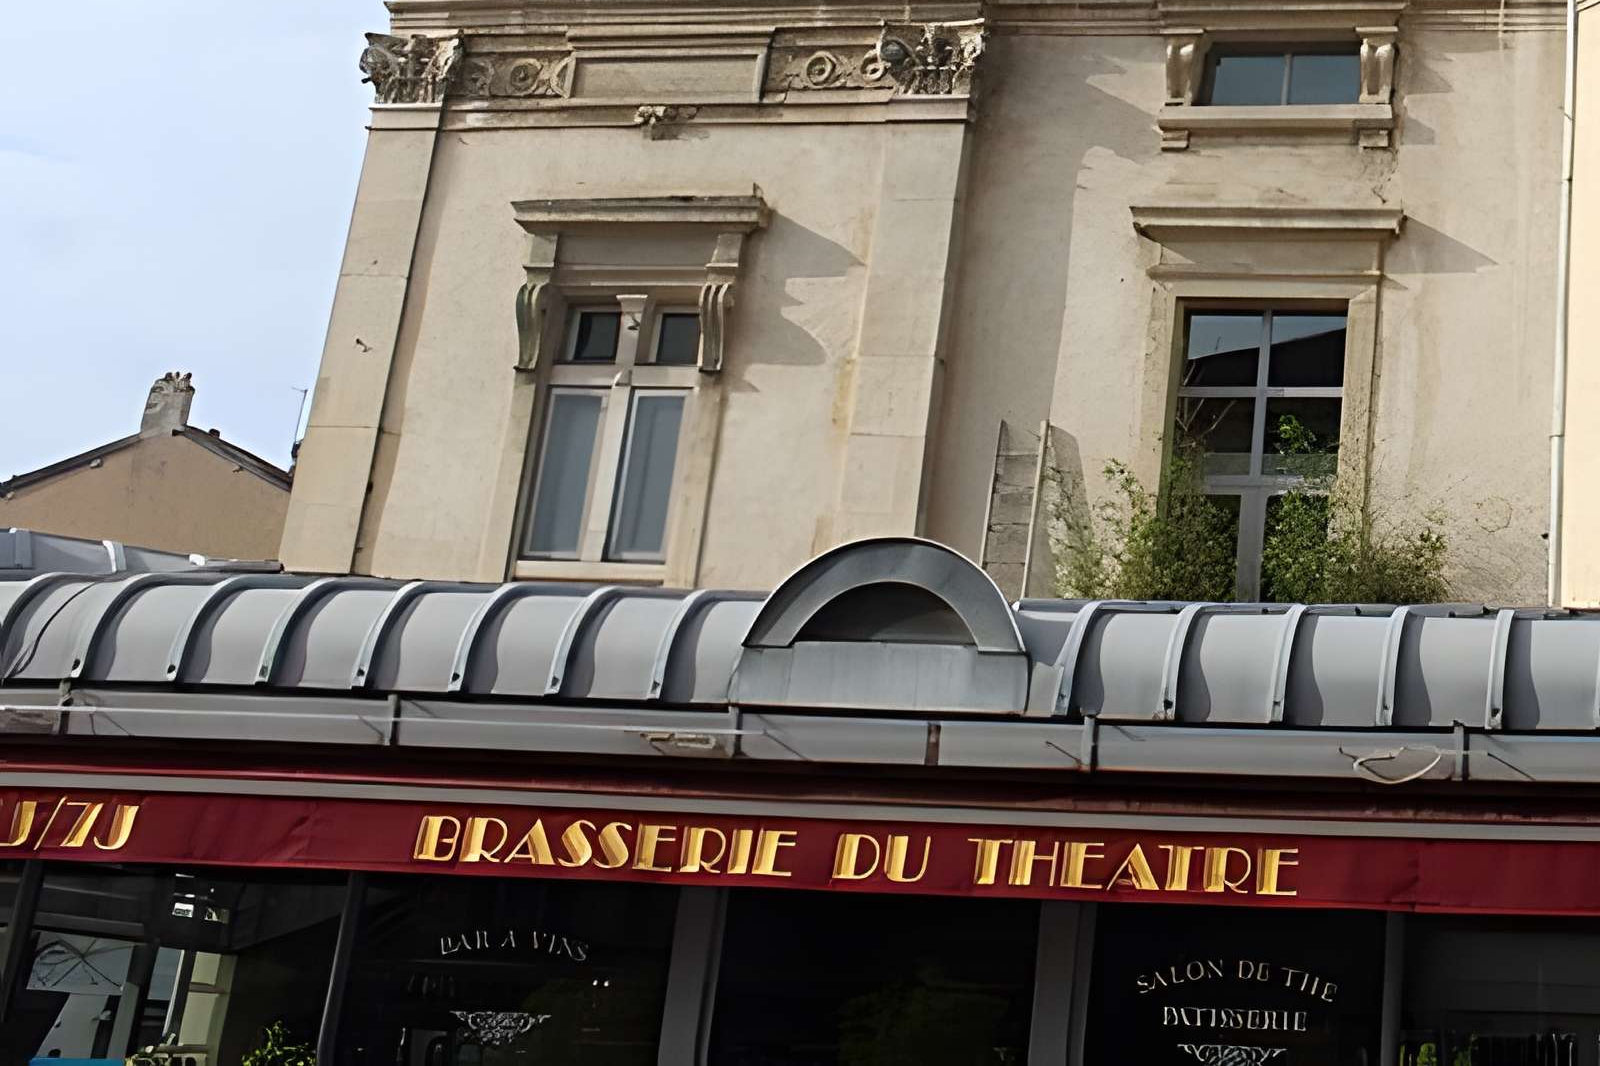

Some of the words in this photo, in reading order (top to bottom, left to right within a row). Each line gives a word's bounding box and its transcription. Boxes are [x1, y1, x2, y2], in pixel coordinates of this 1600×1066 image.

[0, 796, 140, 850] J/7J
[413, 815, 797, 877] BRASSERIE
[832, 833, 931, 883] DU
[967, 837, 1299, 896] THEATRE
[1137, 960, 1223, 994] SALON
